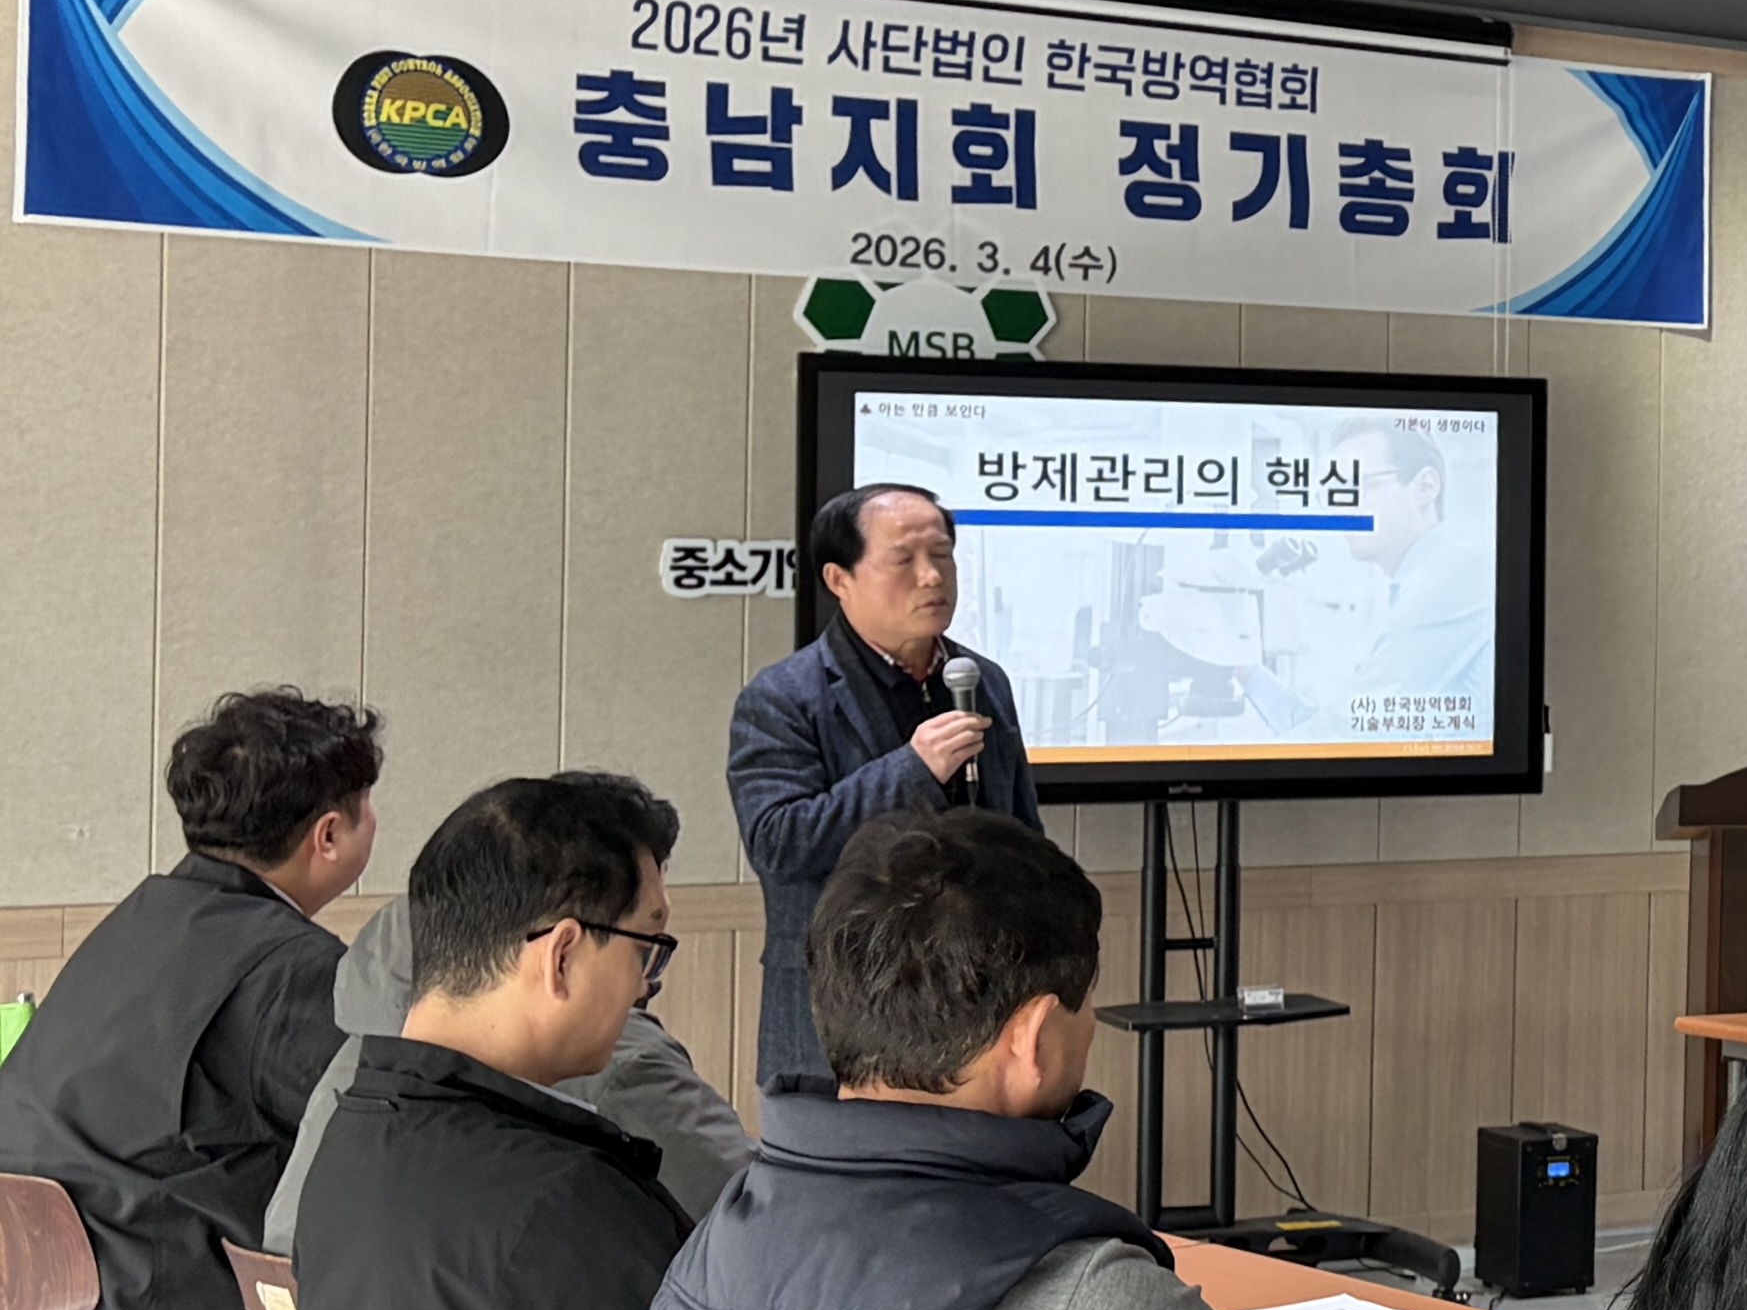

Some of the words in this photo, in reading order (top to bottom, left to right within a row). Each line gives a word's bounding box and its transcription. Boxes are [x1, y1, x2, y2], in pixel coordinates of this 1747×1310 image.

[828, 19, 1025, 86] 사단법인
[1046, 39, 1319, 114] 한국방역협회
[379, 98, 469, 129] KPCA
[572, 68, 1039, 210] 충남지회
[1118, 119, 1516, 245] 정기총회
[850, 232, 957, 272] 2026.
[978, 243, 1011, 276] 3.
[1029, 242, 1120, 284] 4(수)
[888, 330, 976, 359] MSB
[976, 449, 1242, 508] 방제관리의
[1265, 454, 1363, 507] 핵심
[1350, 696, 1376, 714] (사)
[1383, 696, 1472, 713] 한국방역협회
